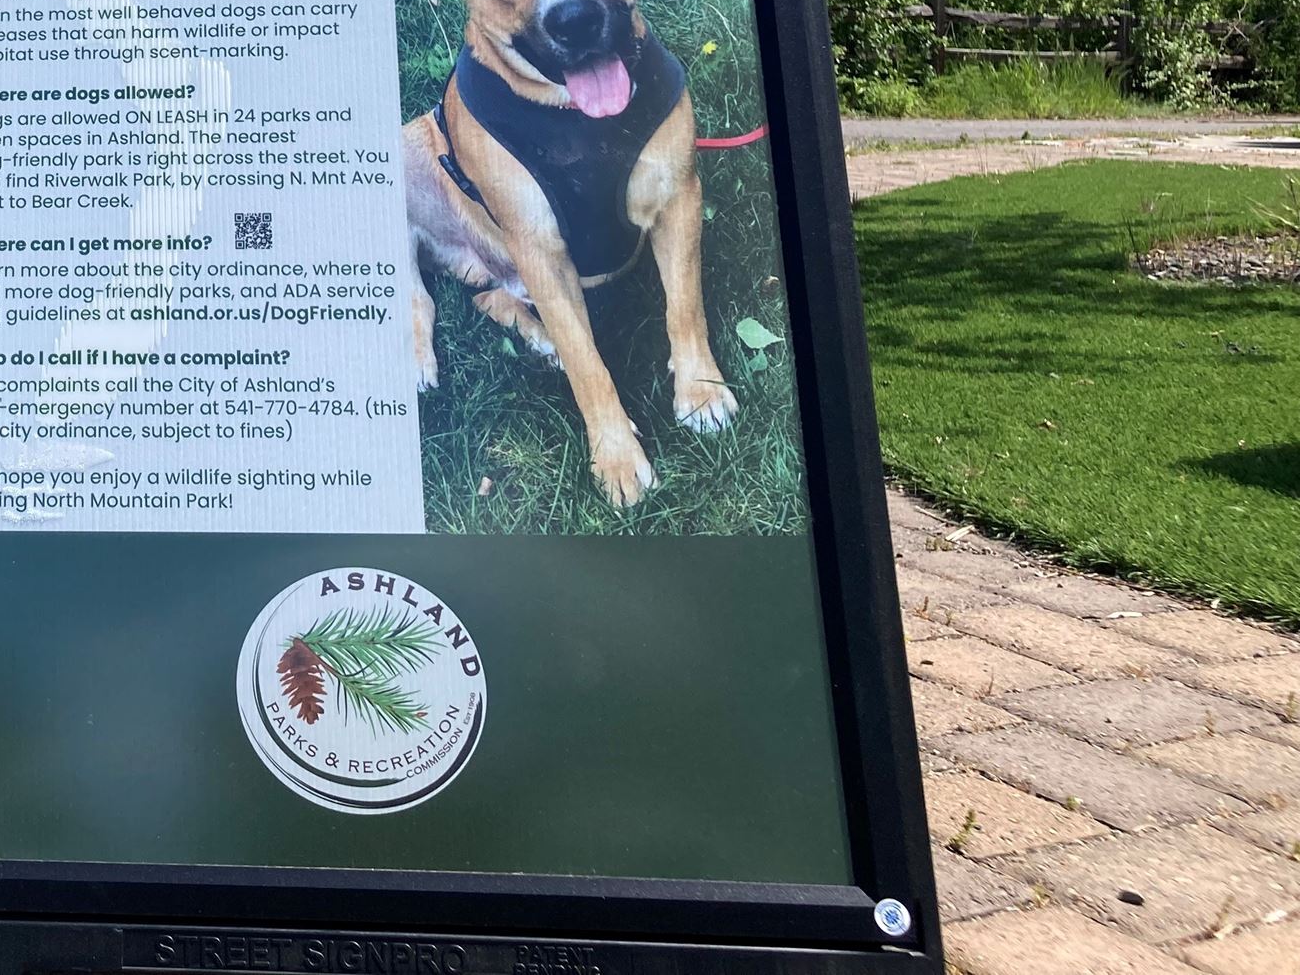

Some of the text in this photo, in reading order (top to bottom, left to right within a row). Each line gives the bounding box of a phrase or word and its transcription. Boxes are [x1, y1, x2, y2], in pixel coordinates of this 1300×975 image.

[14, 6, 45, 22] the
[48, 6, 94, 21] most
[97, 4, 132, 20] well
[136, 2, 220, 19] behaved
[220, 2, 266, 21] dogs
[270, 4, 307, 16] can
[310, 3, 358, 19] carry
[38, 49, 70, 61] use
[71, 44, 146, 64] through
[149, 43, 289, 63] scent-marking.
[30, 89, 62, 101] are
[64, 85, 111, 105] dogs
[113, 84, 196, 100] allowed?
[17, 113, 47, 126] are
[51, 109, 121, 126] allowed
[124, 110, 152, 125] ON
[156, 109, 209, 124] LEASH
[212, 108, 229, 124] in
[233, 108, 257, 123] 24
[260, 107, 311, 127] parks
[315, 106, 352, 123] and
[83, 150, 124, 171] park
[127, 150, 142, 166] is
[146, 149, 191, 170] right
[192, 152, 254, 165] across
[257, 149, 289, 165] the
[292, 150, 351, 164] street.
[354, 149, 390, 164] You
[4, 172, 40, 188] find
[44, 171, 129, 188] Riverwalk
[132, 171, 179, 189] Park,
[180, 170, 205, 191] by
[207, 170, 285, 190] crossing
[289, 171, 307, 186] N.
[311, 171, 347, 186] Mnt
[351, 170, 394, 187] Ave.,
[8, 195, 27, 209] to
[31, 194, 74, 209] Bear
[76, 192, 134, 209] Creek.
[29, 239, 66, 251] can
[69, 236, 75, 251] I
[78, 236, 110, 256] get
[113, 238, 163, 251] more
[165, 234, 213, 251] info?
[20, 265, 70, 277] more
[73, 261, 130, 277] about
[133, 260, 164, 277] the
[168, 261, 202, 281] city
[206, 260, 308, 279] ordinance,
[312, 260, 372, 276] where
[374, 261, 396, 276] to
[5, 305, 101, 326] guidelines
[105, 306, 126, 321] at
[128, 304, 392, 325] ashland.or.us/DogFriendly.
[9, 349, 36, 366] do
[38, 350, 44, 366] I
[45, 349, 83, 366] call
[86, 349, 99, 366] if
[102, 350, 108, 366] I
[111, 349, 161, 366] have
[163, 352, 177, 365] a
[179, 348, 291, 370] complaint?
[120, 399, 195, 416] number
[199, 401, 220, 416] at
[224, 400, 360, 417] 541-770-4784.
[365, 400, 408, 420] (this
[0, 422, 32, 444] city
[36, 422, 137, 441] ordinance,
[141, 422, 211, 444] subject
[215, 424, 235, 439] to
[239, 422, 294, 442] fines)
[49, 472, 85, 490] you
[89, 469, 143, 490] enjoy
[146, 472, 160, 486] a
[164, 469, 233, 486] wildlife
[236, 469, 316, 491] sighting
[320, 469, 373, 487] while
[32, 491, 85, 509] North
[90, 492, 181, 509] Mountain
[186, 492, 233, 509] Park!
[320, 572, 481, 677] ASHLAND
[266, 701, 461, 774] PARKS & RECREATION
[406, 727, 463, 779] COMMISSION
[155, 934, 467, 974] STREET SIGNPRO
[516, 945, 595, 964] PATENT
